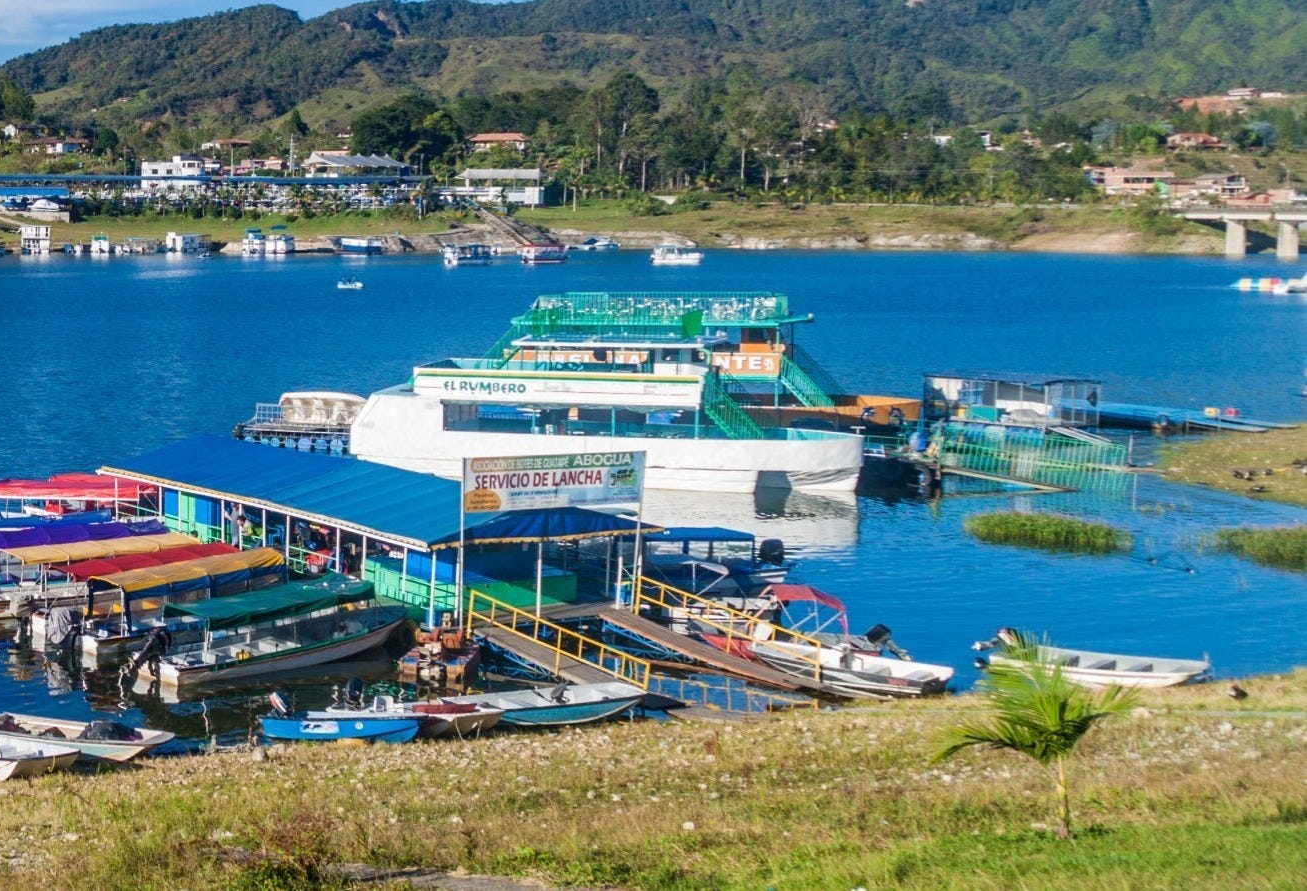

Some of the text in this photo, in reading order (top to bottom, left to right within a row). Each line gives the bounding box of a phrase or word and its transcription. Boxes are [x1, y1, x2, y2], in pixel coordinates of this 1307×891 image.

[444, 380, 526, 395] EL RUMBERO
[573, 453, 631, 466] ABOGUA
[475, 473, 530, 490] SERVICIO
[532, 472, 549, 487] DE
[552, 471, 602, 486] LANCHA
